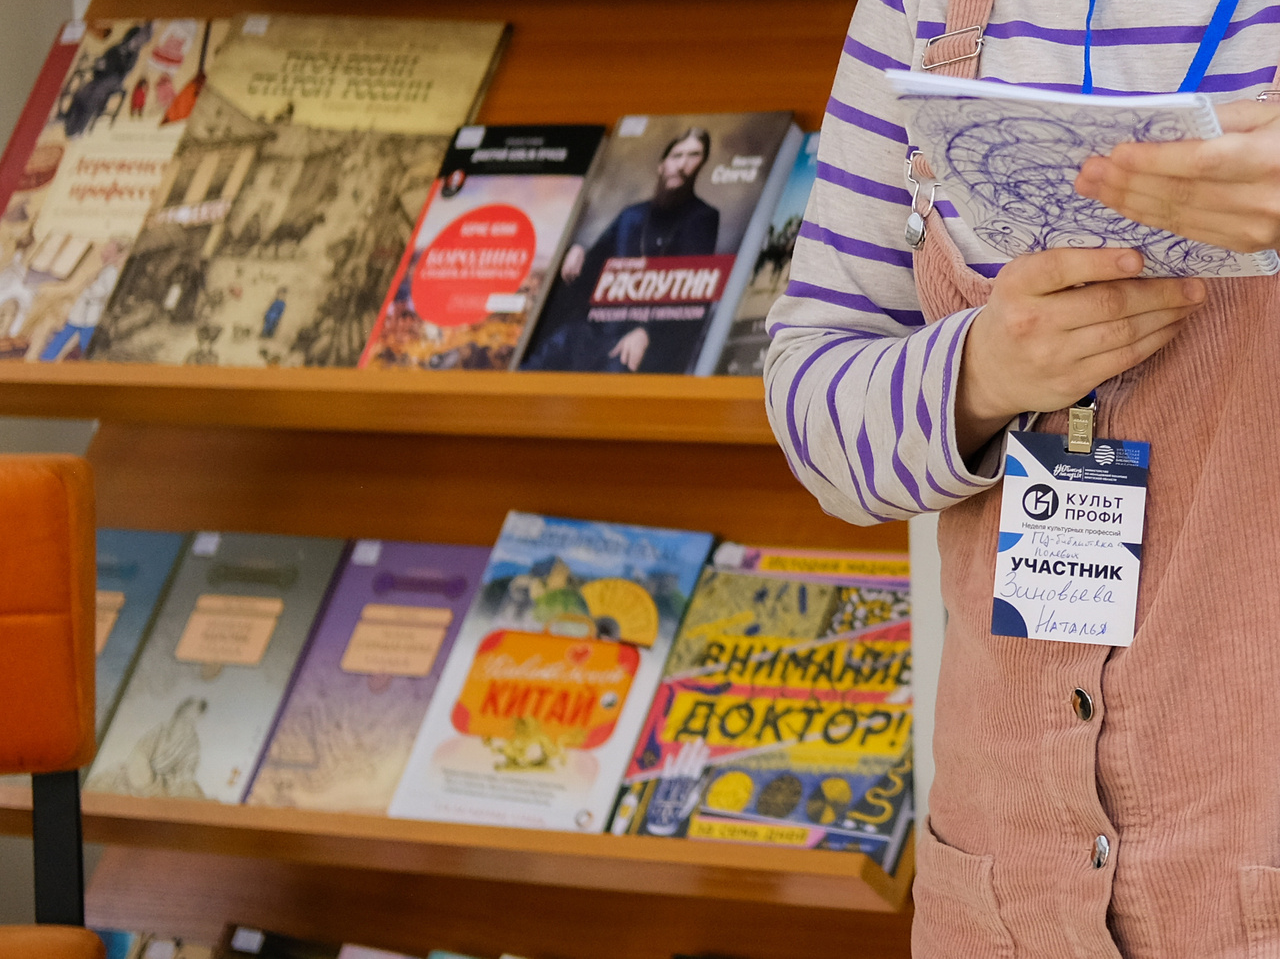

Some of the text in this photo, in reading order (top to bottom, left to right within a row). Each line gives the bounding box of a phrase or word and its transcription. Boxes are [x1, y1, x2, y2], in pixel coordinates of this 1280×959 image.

[593, 267, 722, 303] РАСПУТИН
[1066, 493, 1124, 510] КУЛЬТ
[1021, 522, 1121, 537] Неделя культурных профессий
[1065, 508, 1123, 525] ПРОФИ
[1010, 556, 1124, 581] УЧАСТНИК
[999, 571, 1116, 604] Зиновьева
[479, 681, 598, 728] КИТАЙ
[678, 699, 908, 748] ДОКТОР!
